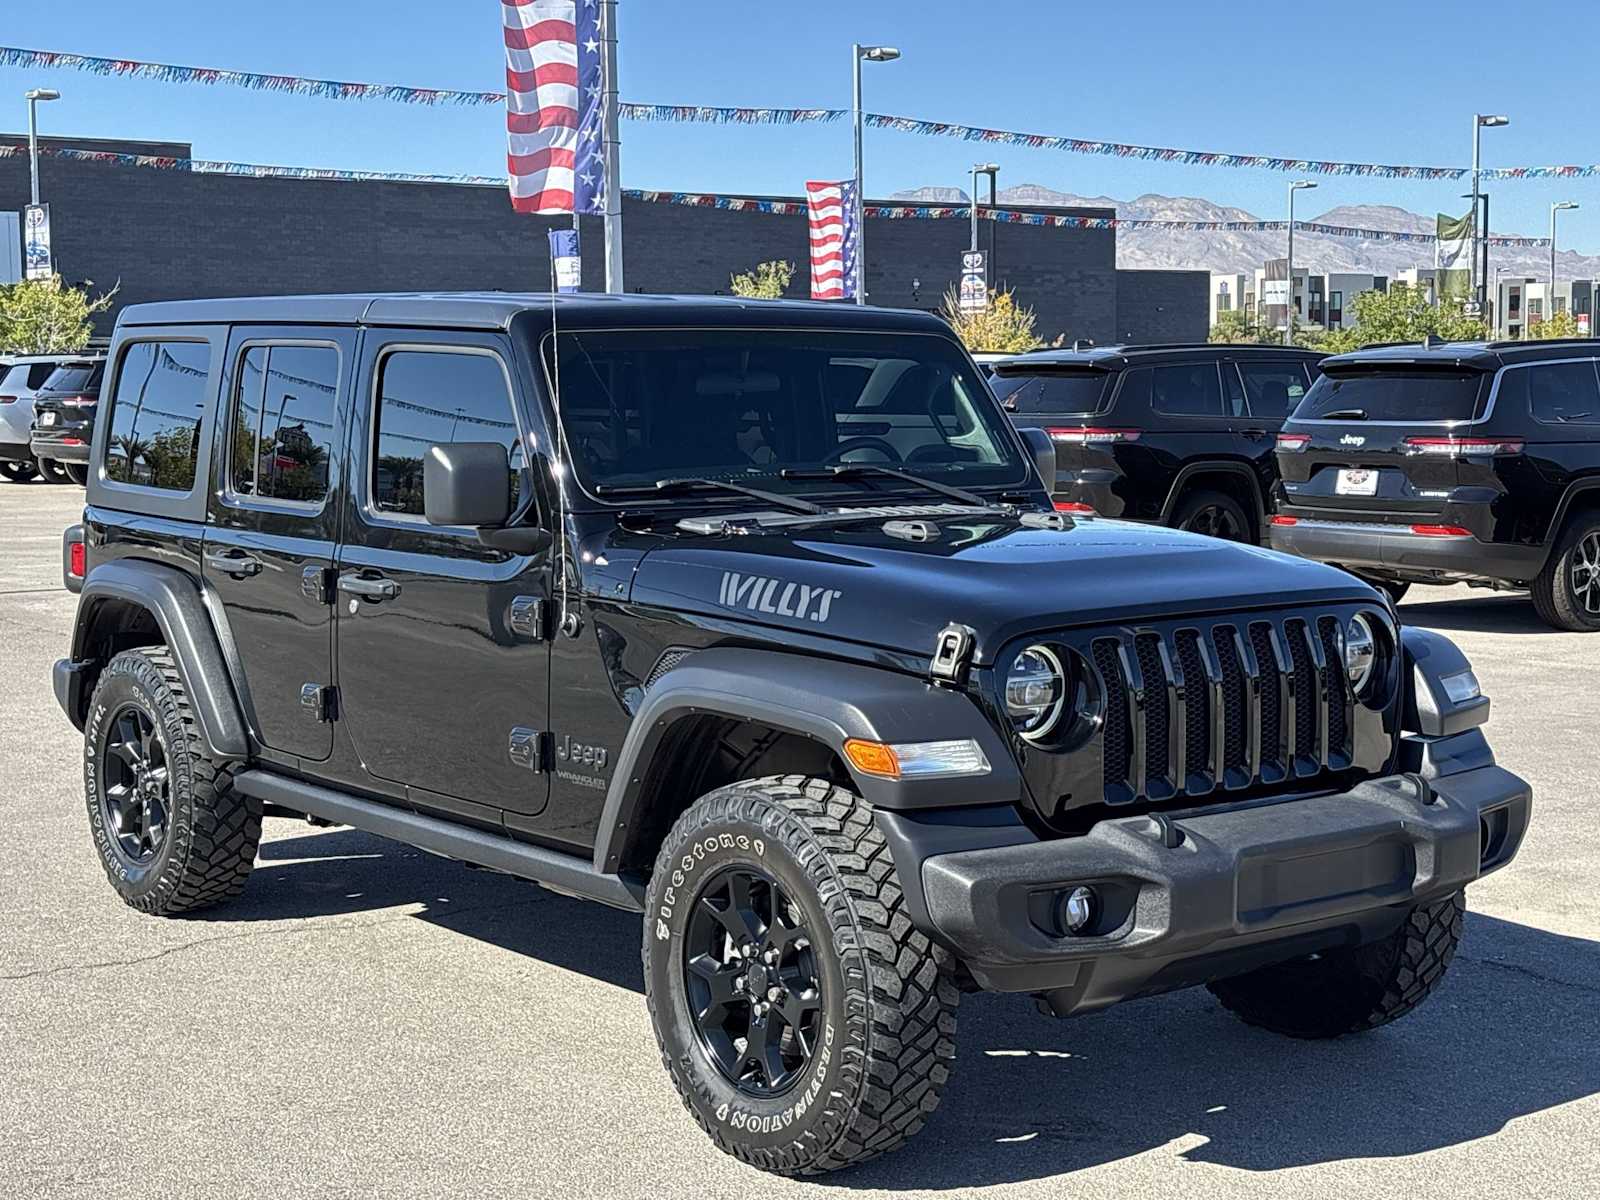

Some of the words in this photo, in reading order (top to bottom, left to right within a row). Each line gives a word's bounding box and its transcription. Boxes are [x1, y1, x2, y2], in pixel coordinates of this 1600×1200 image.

[1340, 434, 1365, 447] Jeep
[719, 571, 842, 622] WILLYS
[557, 735, 607, 772] Jeep
[656, 832, 750, 941] Firestone
[730, 1024, 835, 1133] DESTINATION
